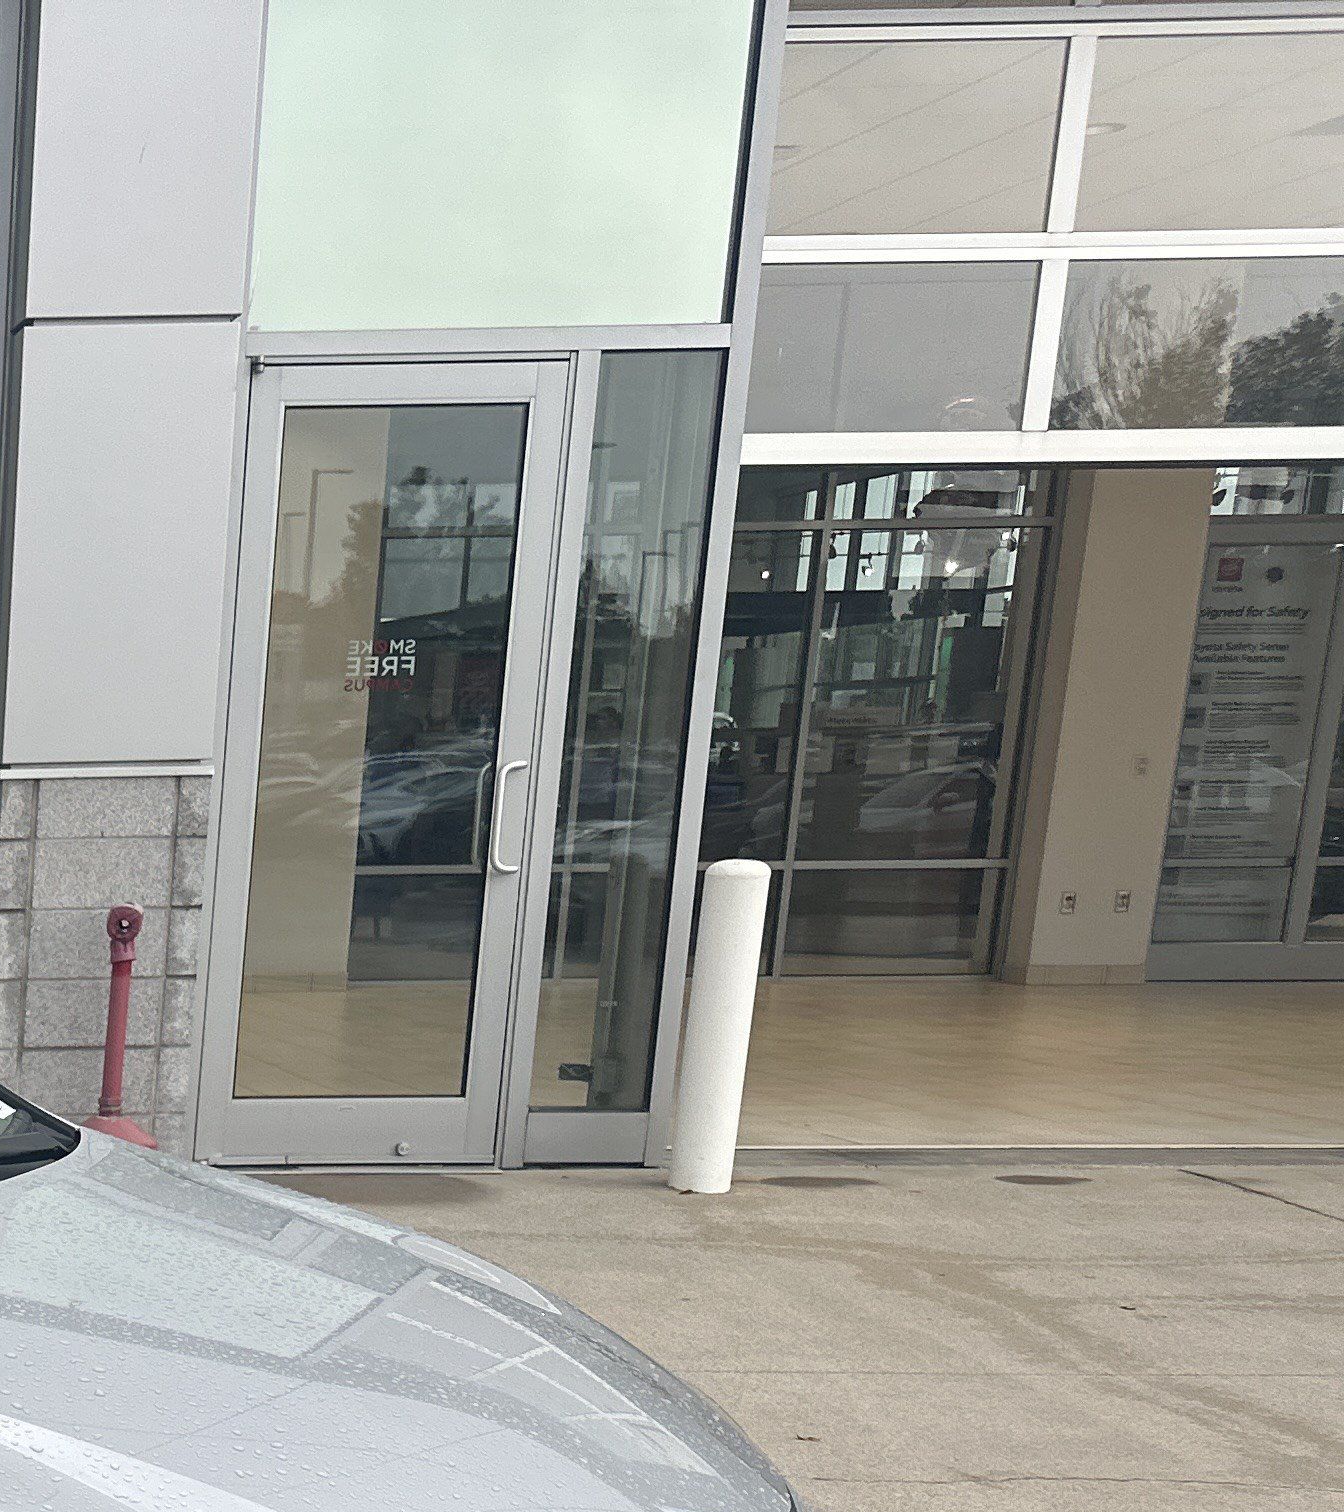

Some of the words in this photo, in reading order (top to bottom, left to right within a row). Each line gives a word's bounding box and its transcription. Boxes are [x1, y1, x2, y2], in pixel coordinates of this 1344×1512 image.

[1199, 606, 1245, 620] signed
[1246, 605, 1263, 617] for
[1265, 606, 1311, 620] Safety
